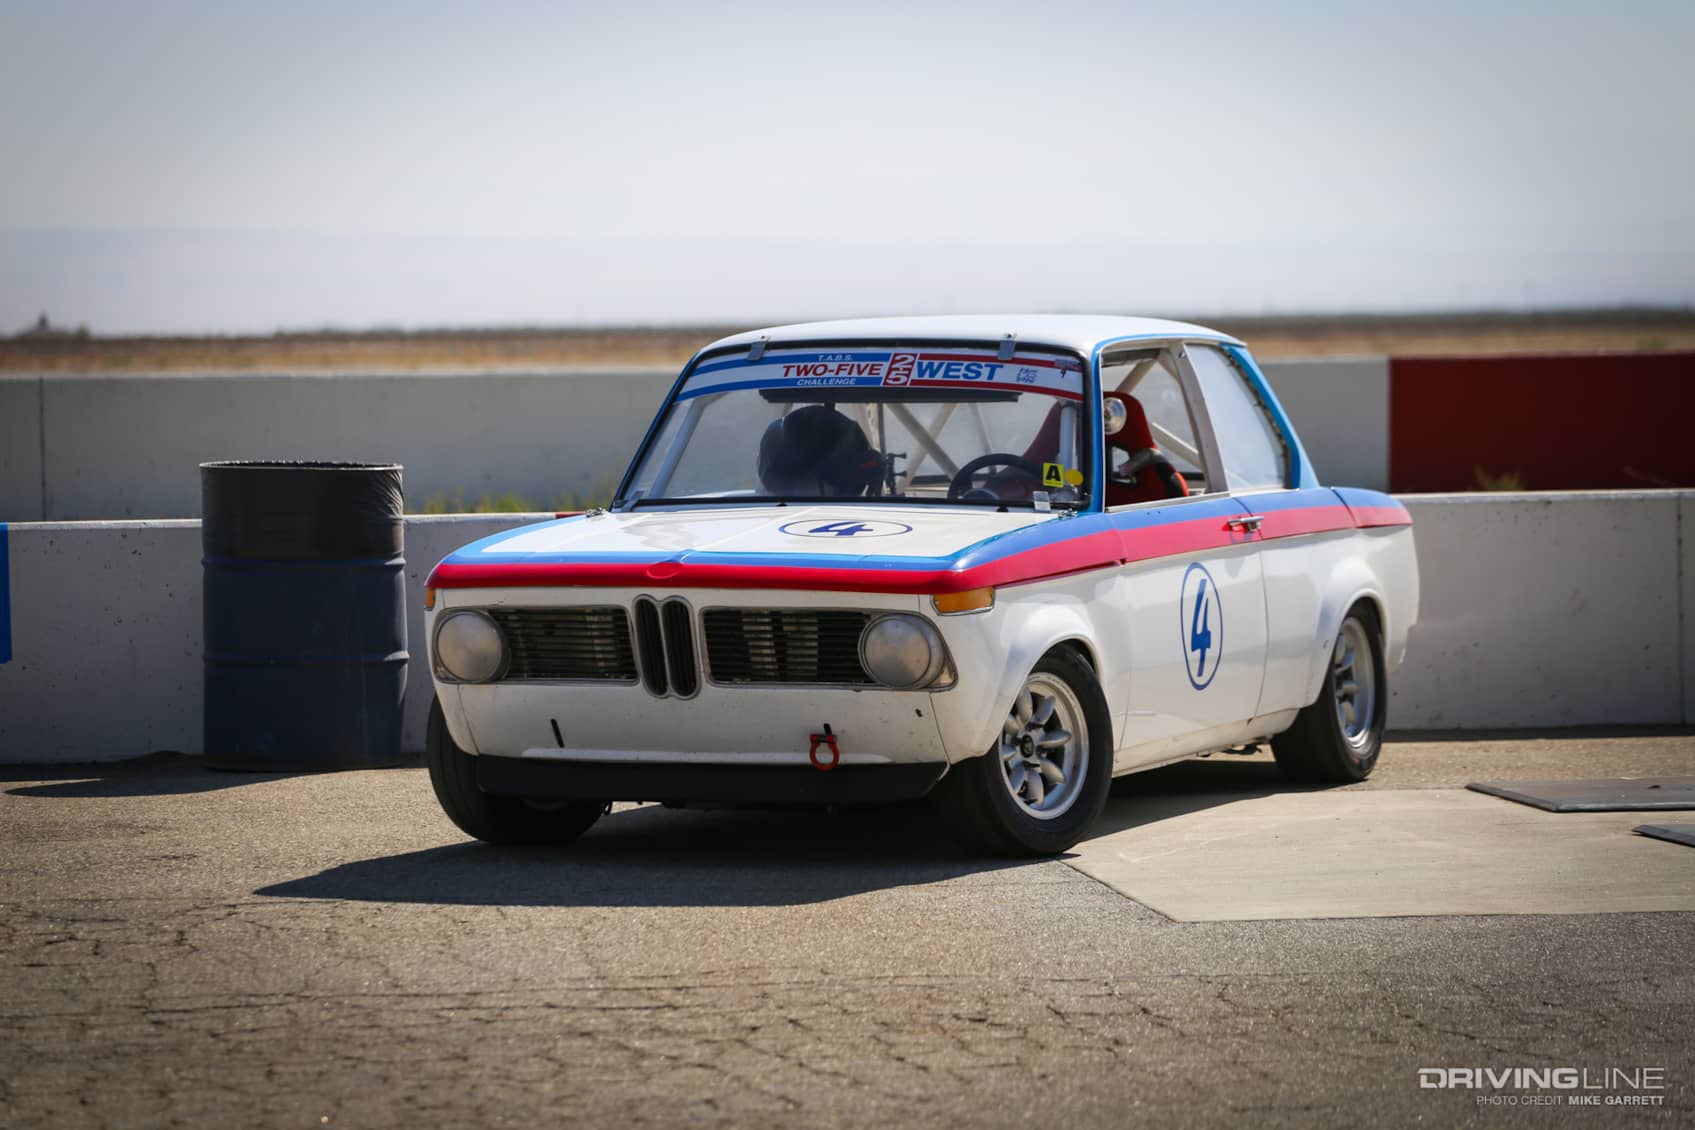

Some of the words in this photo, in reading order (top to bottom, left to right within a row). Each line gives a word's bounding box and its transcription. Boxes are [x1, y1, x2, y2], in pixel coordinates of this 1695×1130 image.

[782, 363, 884, 377] TWO-FIVE
[916, 361, 1004, 380] WEST
[796, 378, 857, 386] CHALLENGE
[1046, 465, 1061, 481] A
[807, 521, 874, 536] 4
[1191, 578, 1211, 677] 4
